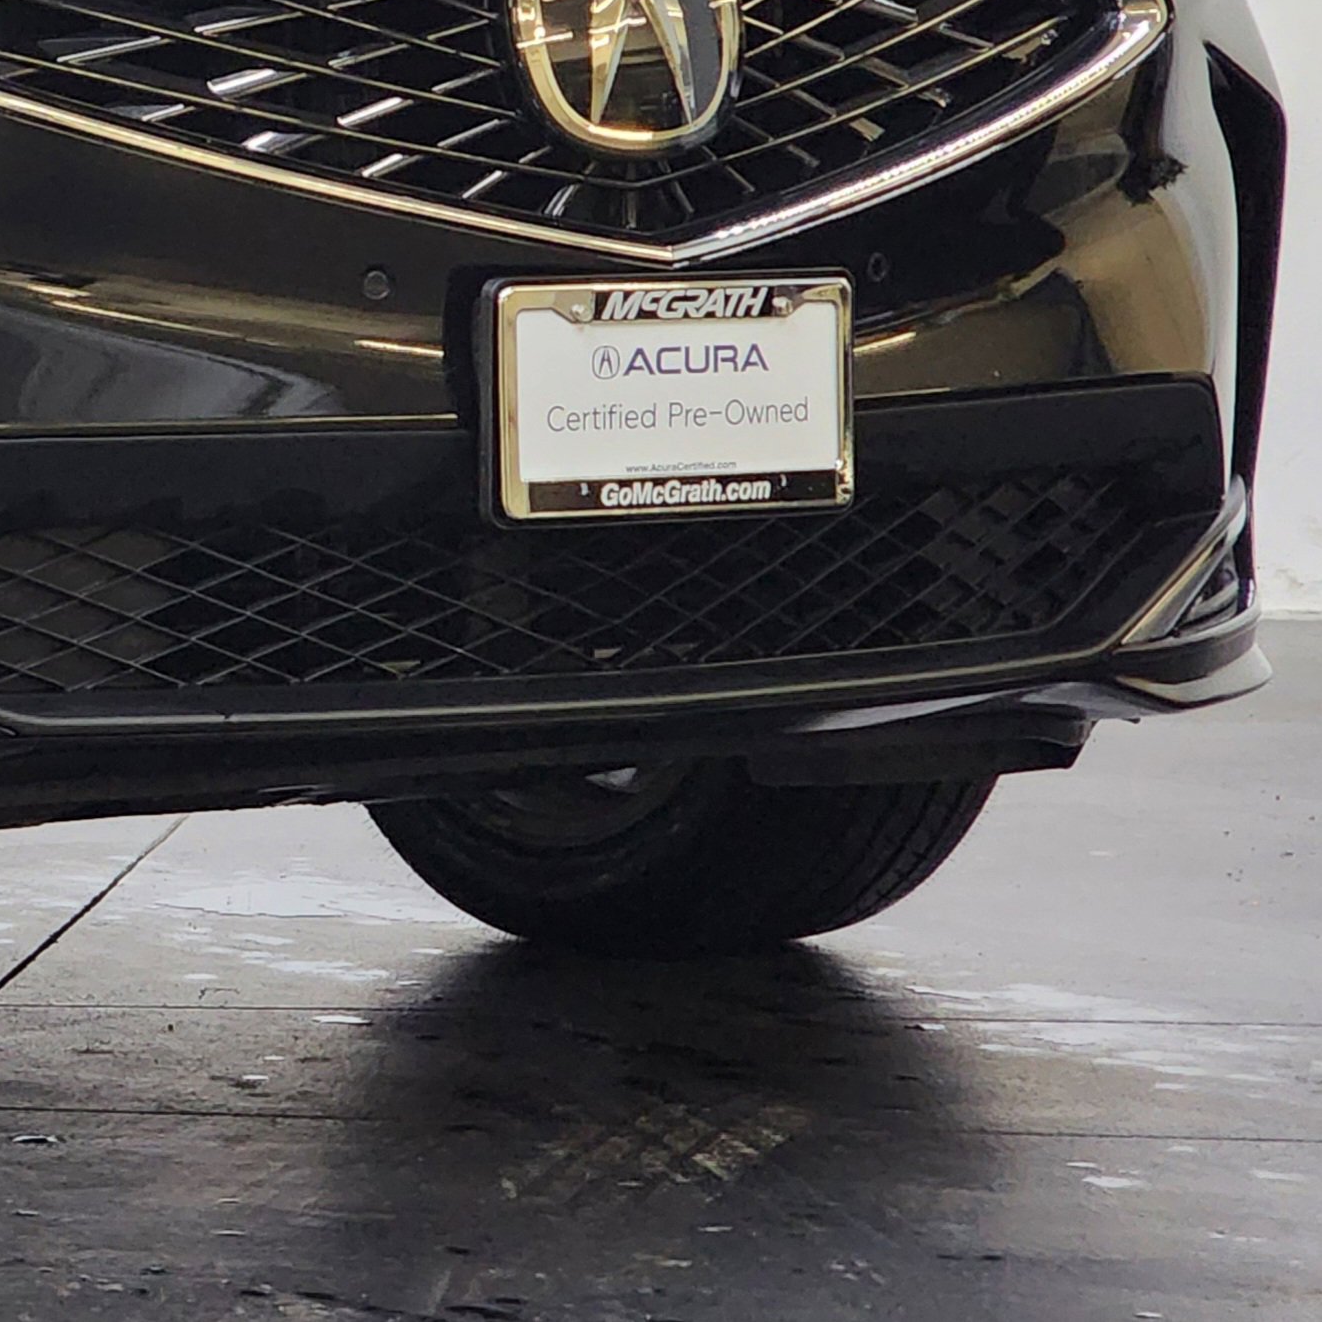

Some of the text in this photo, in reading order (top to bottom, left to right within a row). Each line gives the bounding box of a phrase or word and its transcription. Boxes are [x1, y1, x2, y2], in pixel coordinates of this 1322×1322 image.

[623, 343, 769, 376] ACURA
[547, 396, 808, 432] Certified Pre-Owned
[625, 461, 737, 473] www.AcuraCertified.com
[600, 478, 772, 506] GoMcGrath.com
